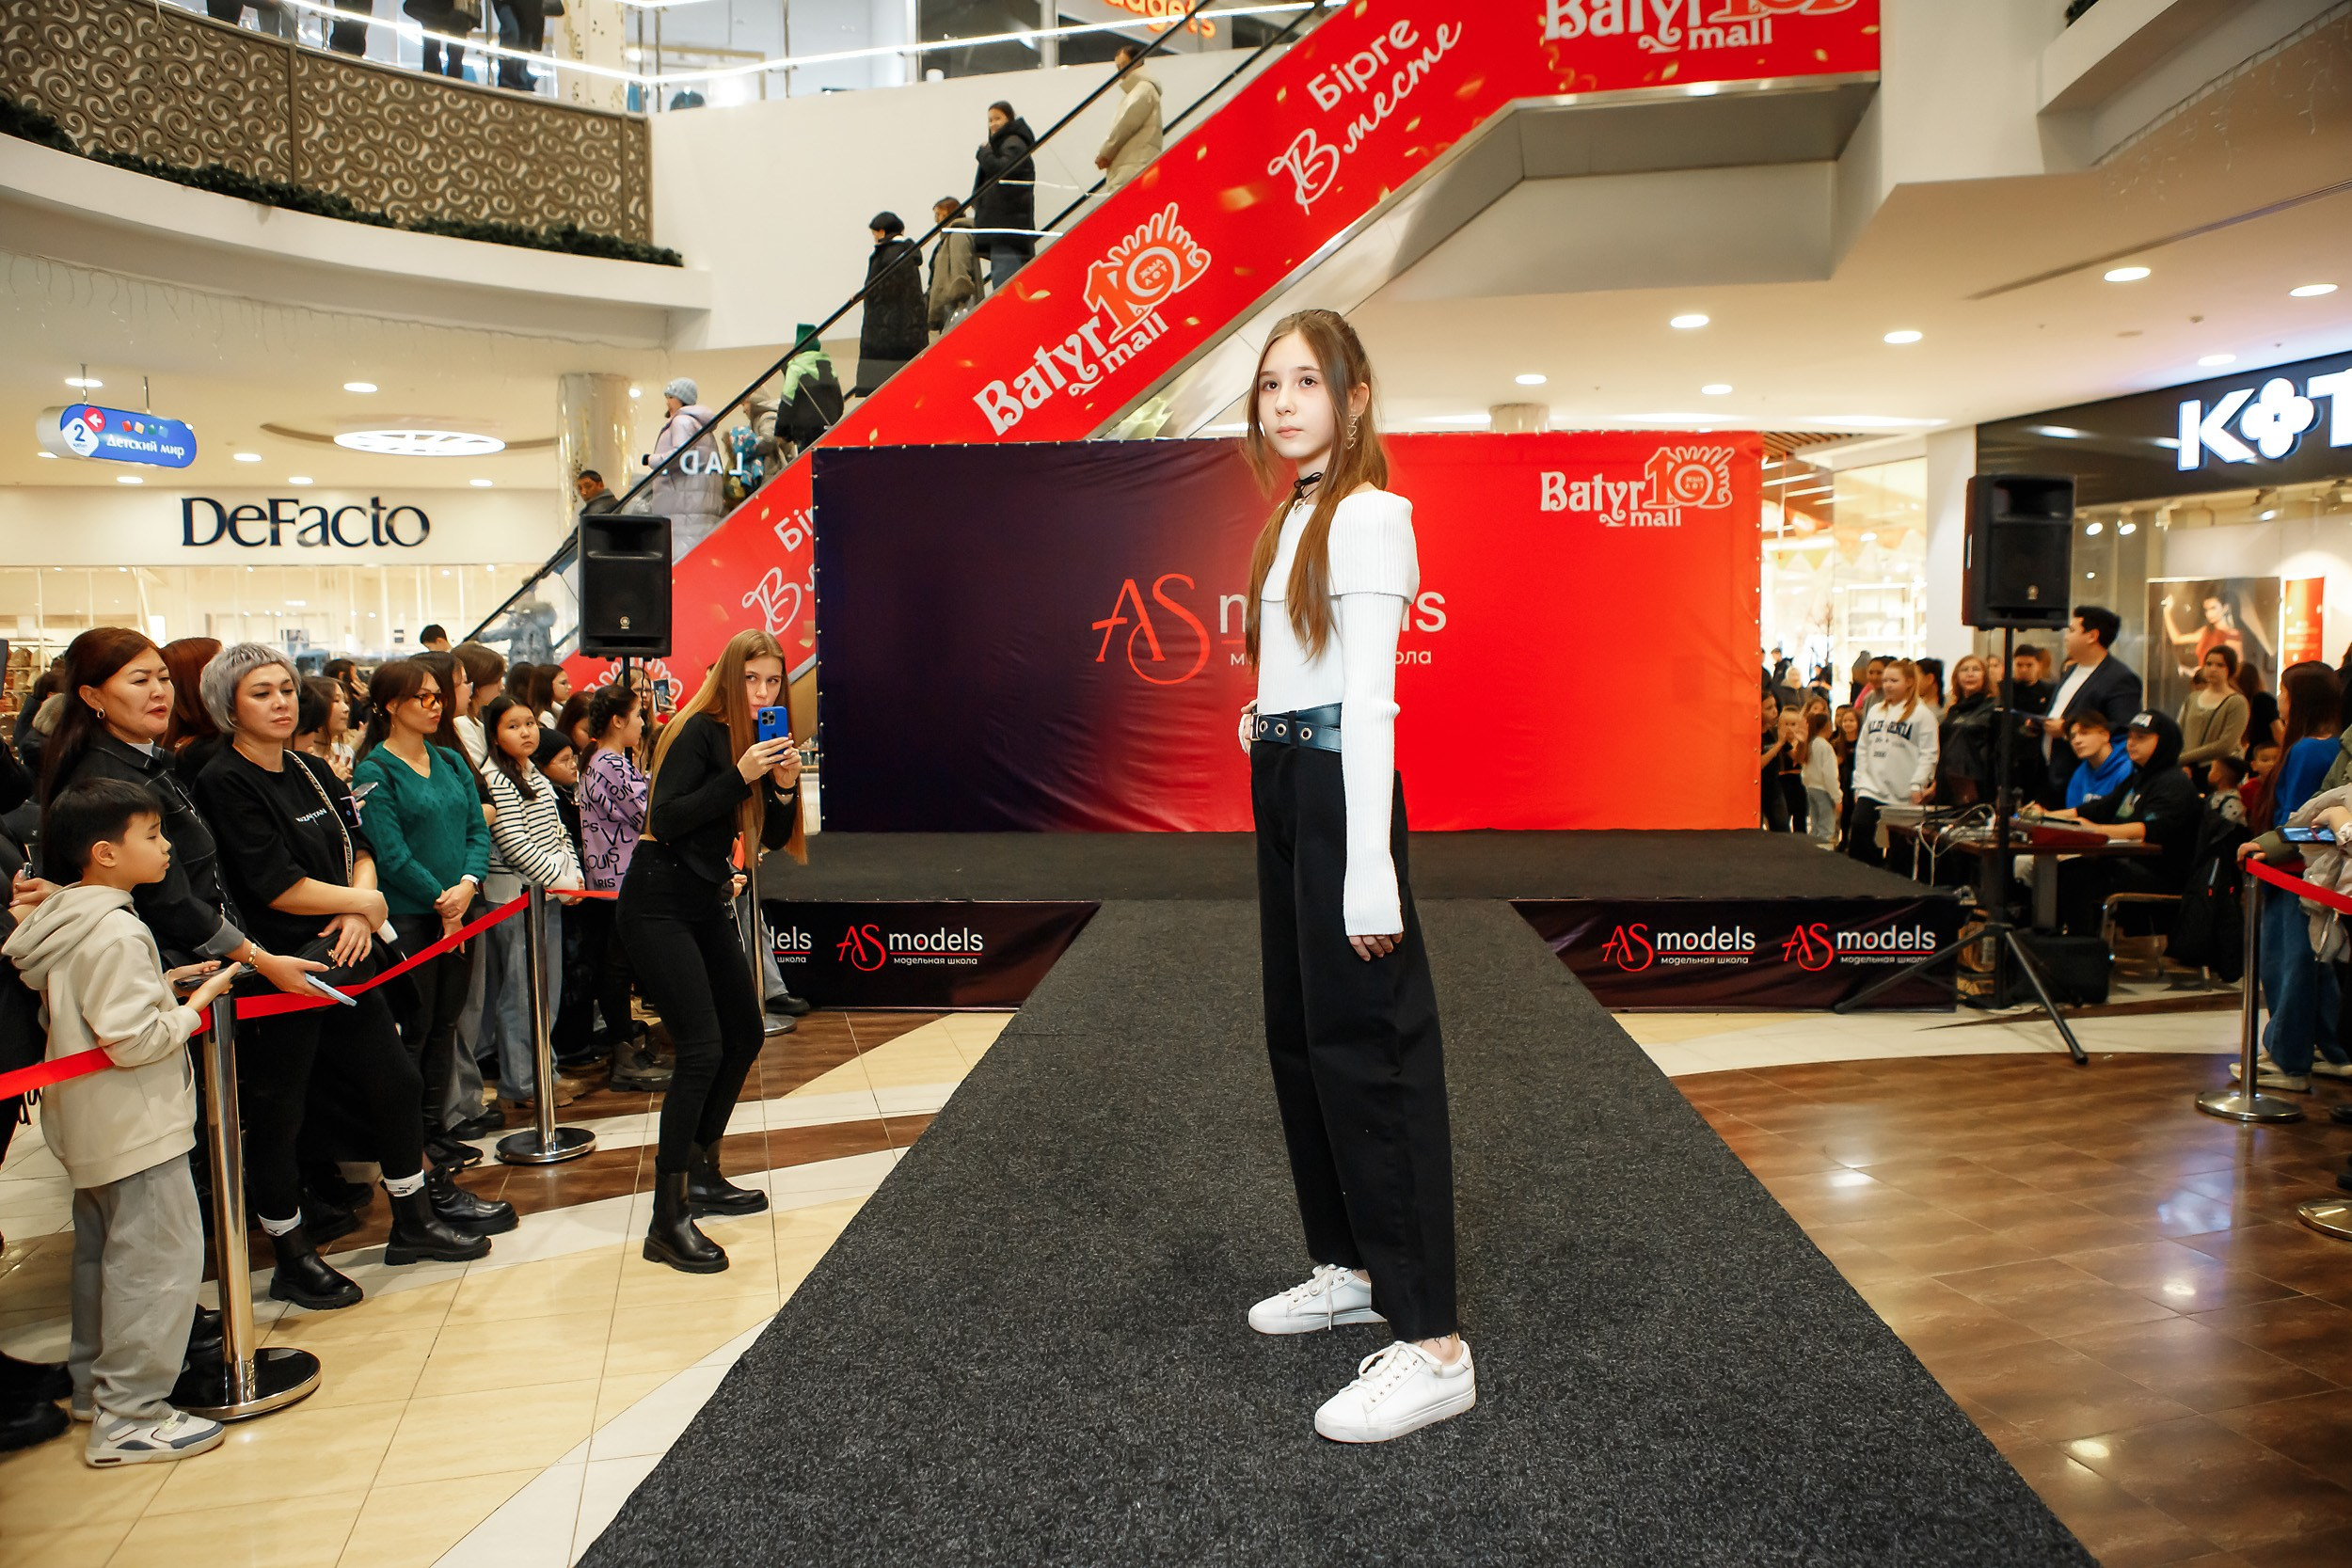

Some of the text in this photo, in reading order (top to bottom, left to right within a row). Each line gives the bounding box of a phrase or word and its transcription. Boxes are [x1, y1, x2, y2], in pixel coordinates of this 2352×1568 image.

[1688, 18, 1772, 50] mall
[1307, 19, 1419, 112] Бірге
[1100, 311, 1169, 373] mall
[973, 315, 1107, 436] Batyr
[74, 423, 86, 442] 2
[106, 434, 157, 452] Детский
[160, 445, 184, 459] мир
[1540, 471, 1645, 527] Batyr
[181, 497, 430, 547] DeFacto
[1629, 508, 1681, 527] mall
[1092, 573, 1210, 685] AS
[1395, 651, 1431, 665] ола
[771, 926, 812, 950] els
[836, 924, 984, 972] AS models
[1601, 923, 1756, 972] AS models
[1782, 923, 1936, 972] AS models
[777, 956, 806, 964] школа
[894, 957, 977, 966] модельная школа
[1661, 956, 1749, 965] модельная школа
[1840, 956, 1895, 965] модельная
